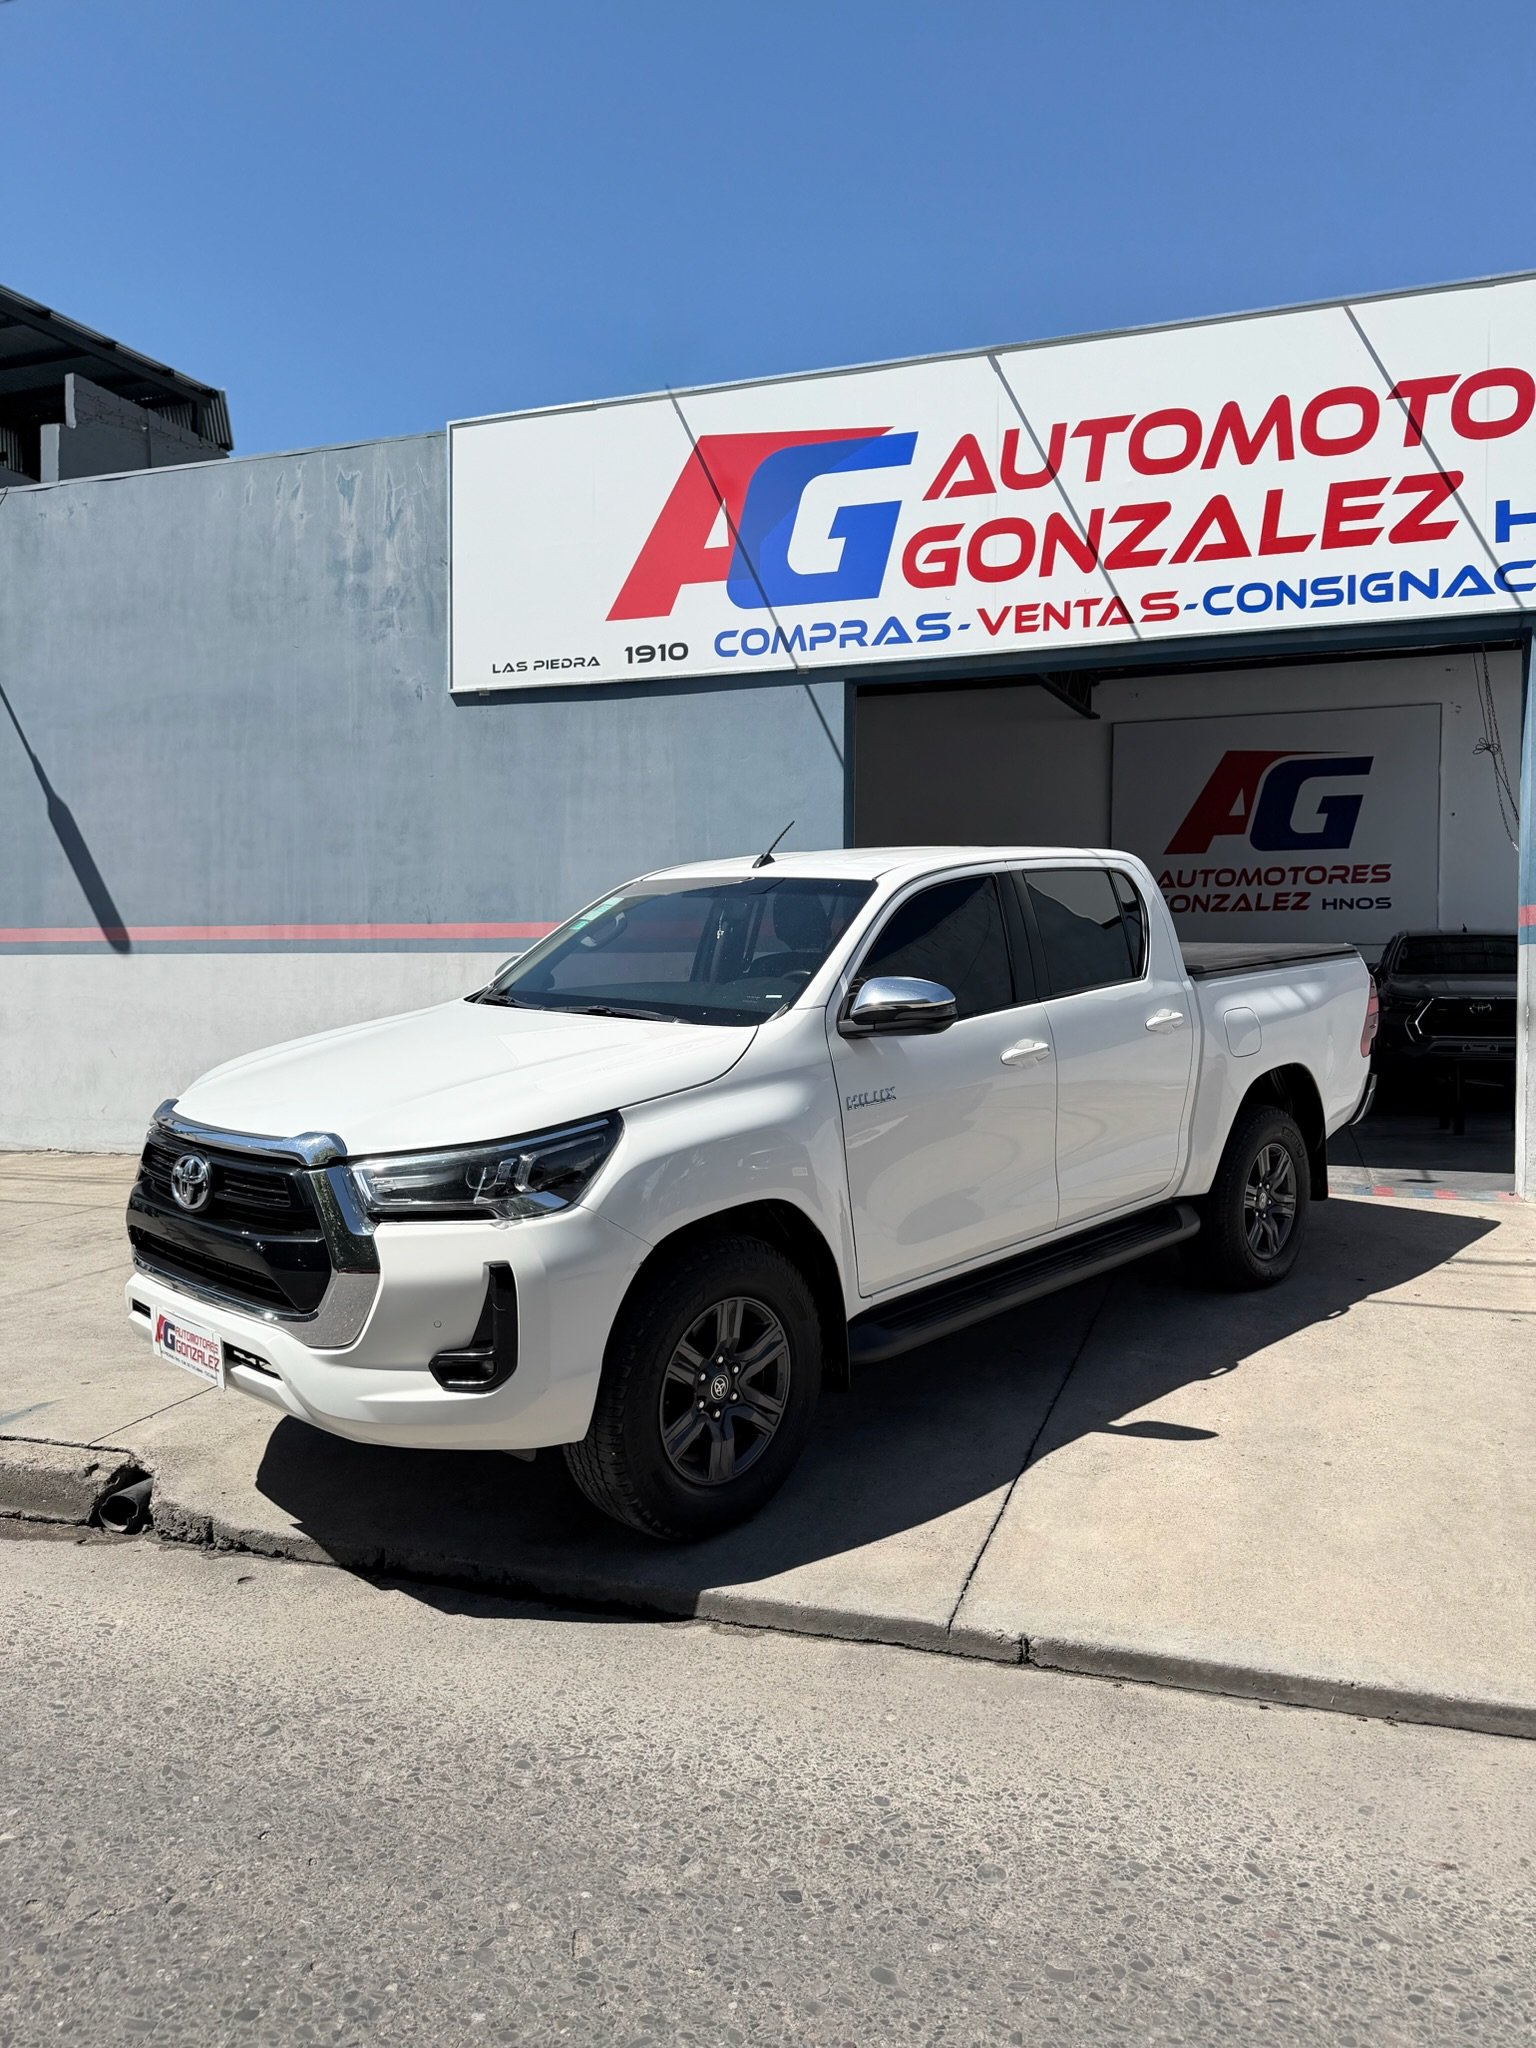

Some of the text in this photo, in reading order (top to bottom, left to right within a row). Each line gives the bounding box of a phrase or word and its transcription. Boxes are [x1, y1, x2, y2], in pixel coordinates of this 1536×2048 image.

[923, 367, 1536, 501] AUTOMOTO
[606, 426, 919, 622] AG
[901, 469, 1465, 589] GONZALEZ
[491, 642, 689, 674] LAS PIEDRA 1910
[1163, 750, 1374, 856] AG
[1157, 864, 1393, 889] AUTOMOTORES
[1164, 891, 1393, 913] ONZALEZ HNOS
[176, 1339, 220, 1372] GONZALEZ
